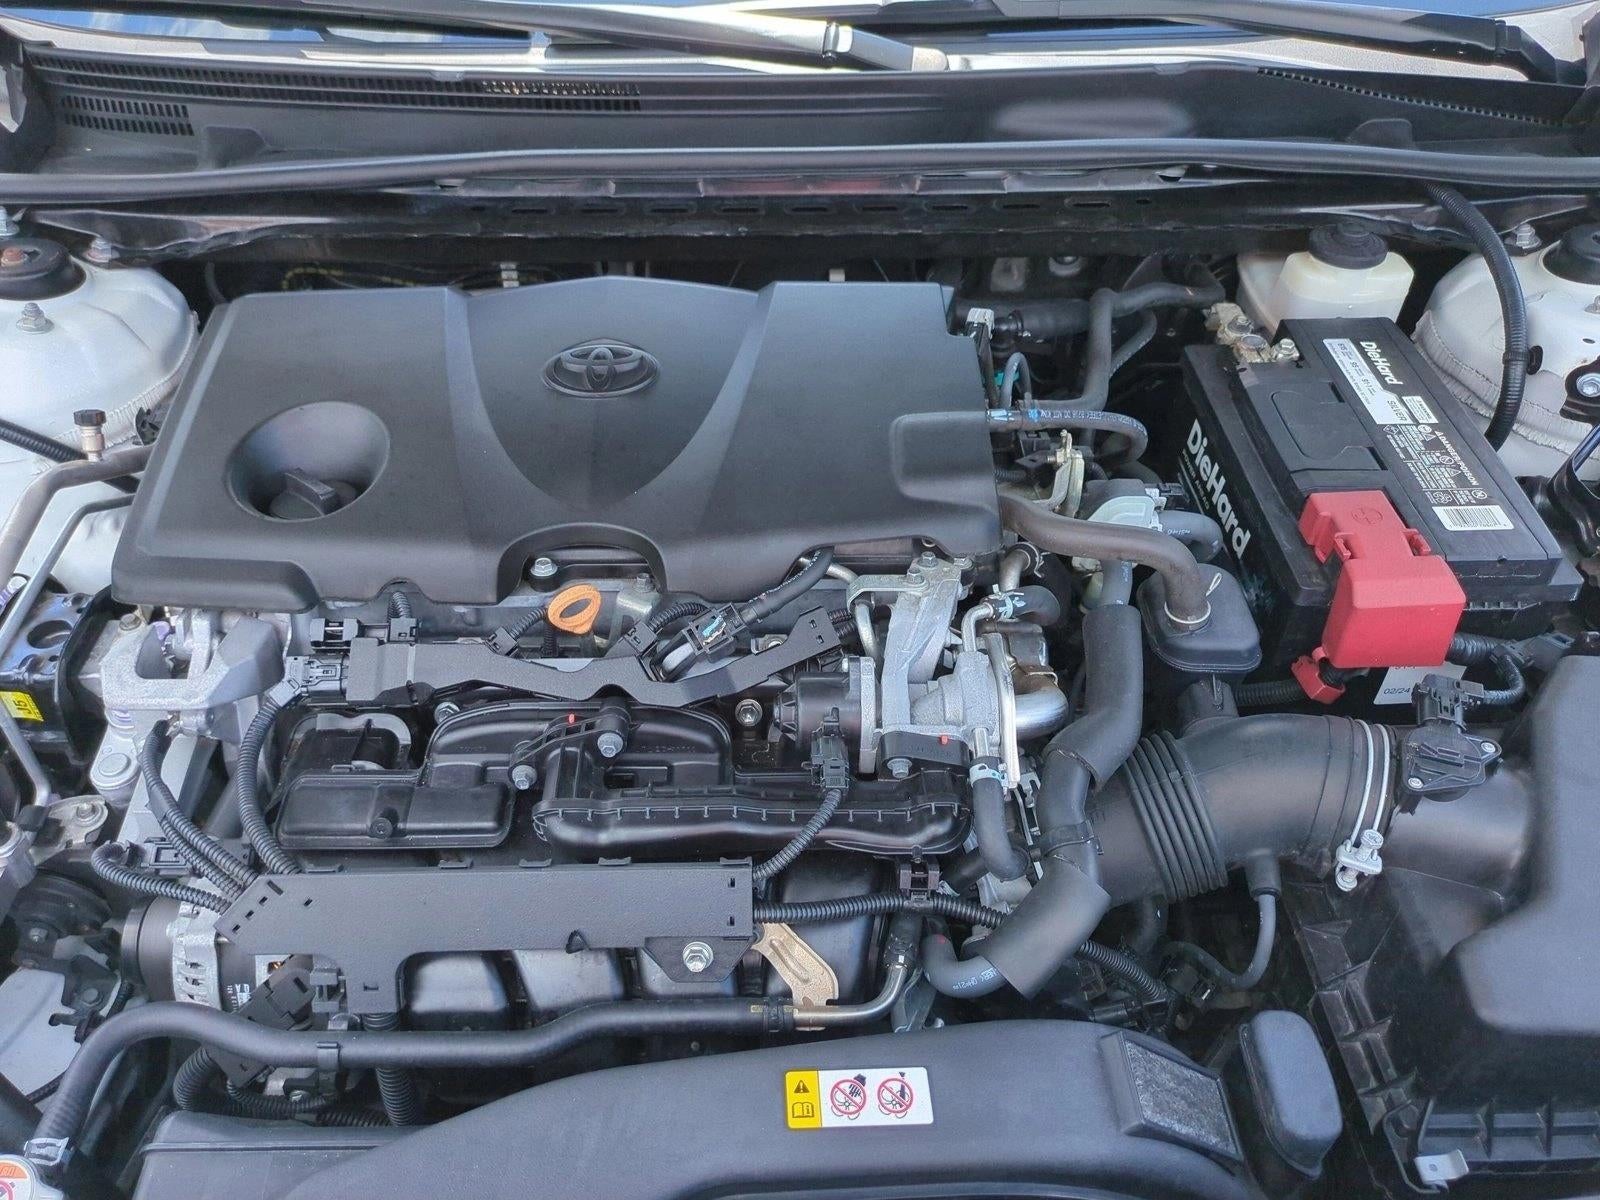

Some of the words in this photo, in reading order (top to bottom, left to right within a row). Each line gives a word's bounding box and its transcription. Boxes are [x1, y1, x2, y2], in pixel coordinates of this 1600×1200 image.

[1360, 341, 1403, 385] DieHard
[1387, 400, 1408, 421] SILVER
[1186, 417, 1251, 560] DieHard
[1383, 687, 1411, 695] 02/24
